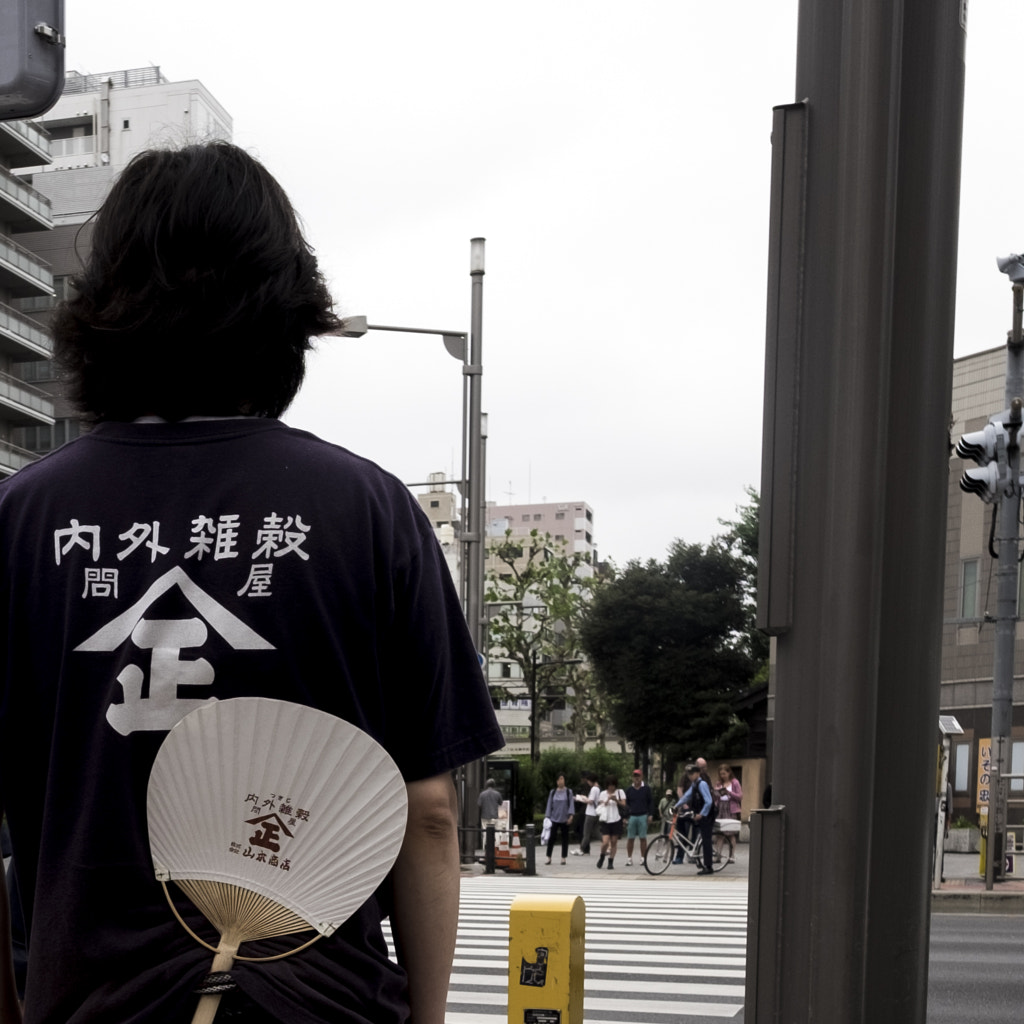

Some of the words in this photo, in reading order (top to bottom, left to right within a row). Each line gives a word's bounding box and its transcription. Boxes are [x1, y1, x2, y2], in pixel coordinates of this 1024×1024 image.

[53, 511, 313, 567] 内外雑穀
[80, 566, 120, 600] 問
[236, 562, 275, 598] 屋
